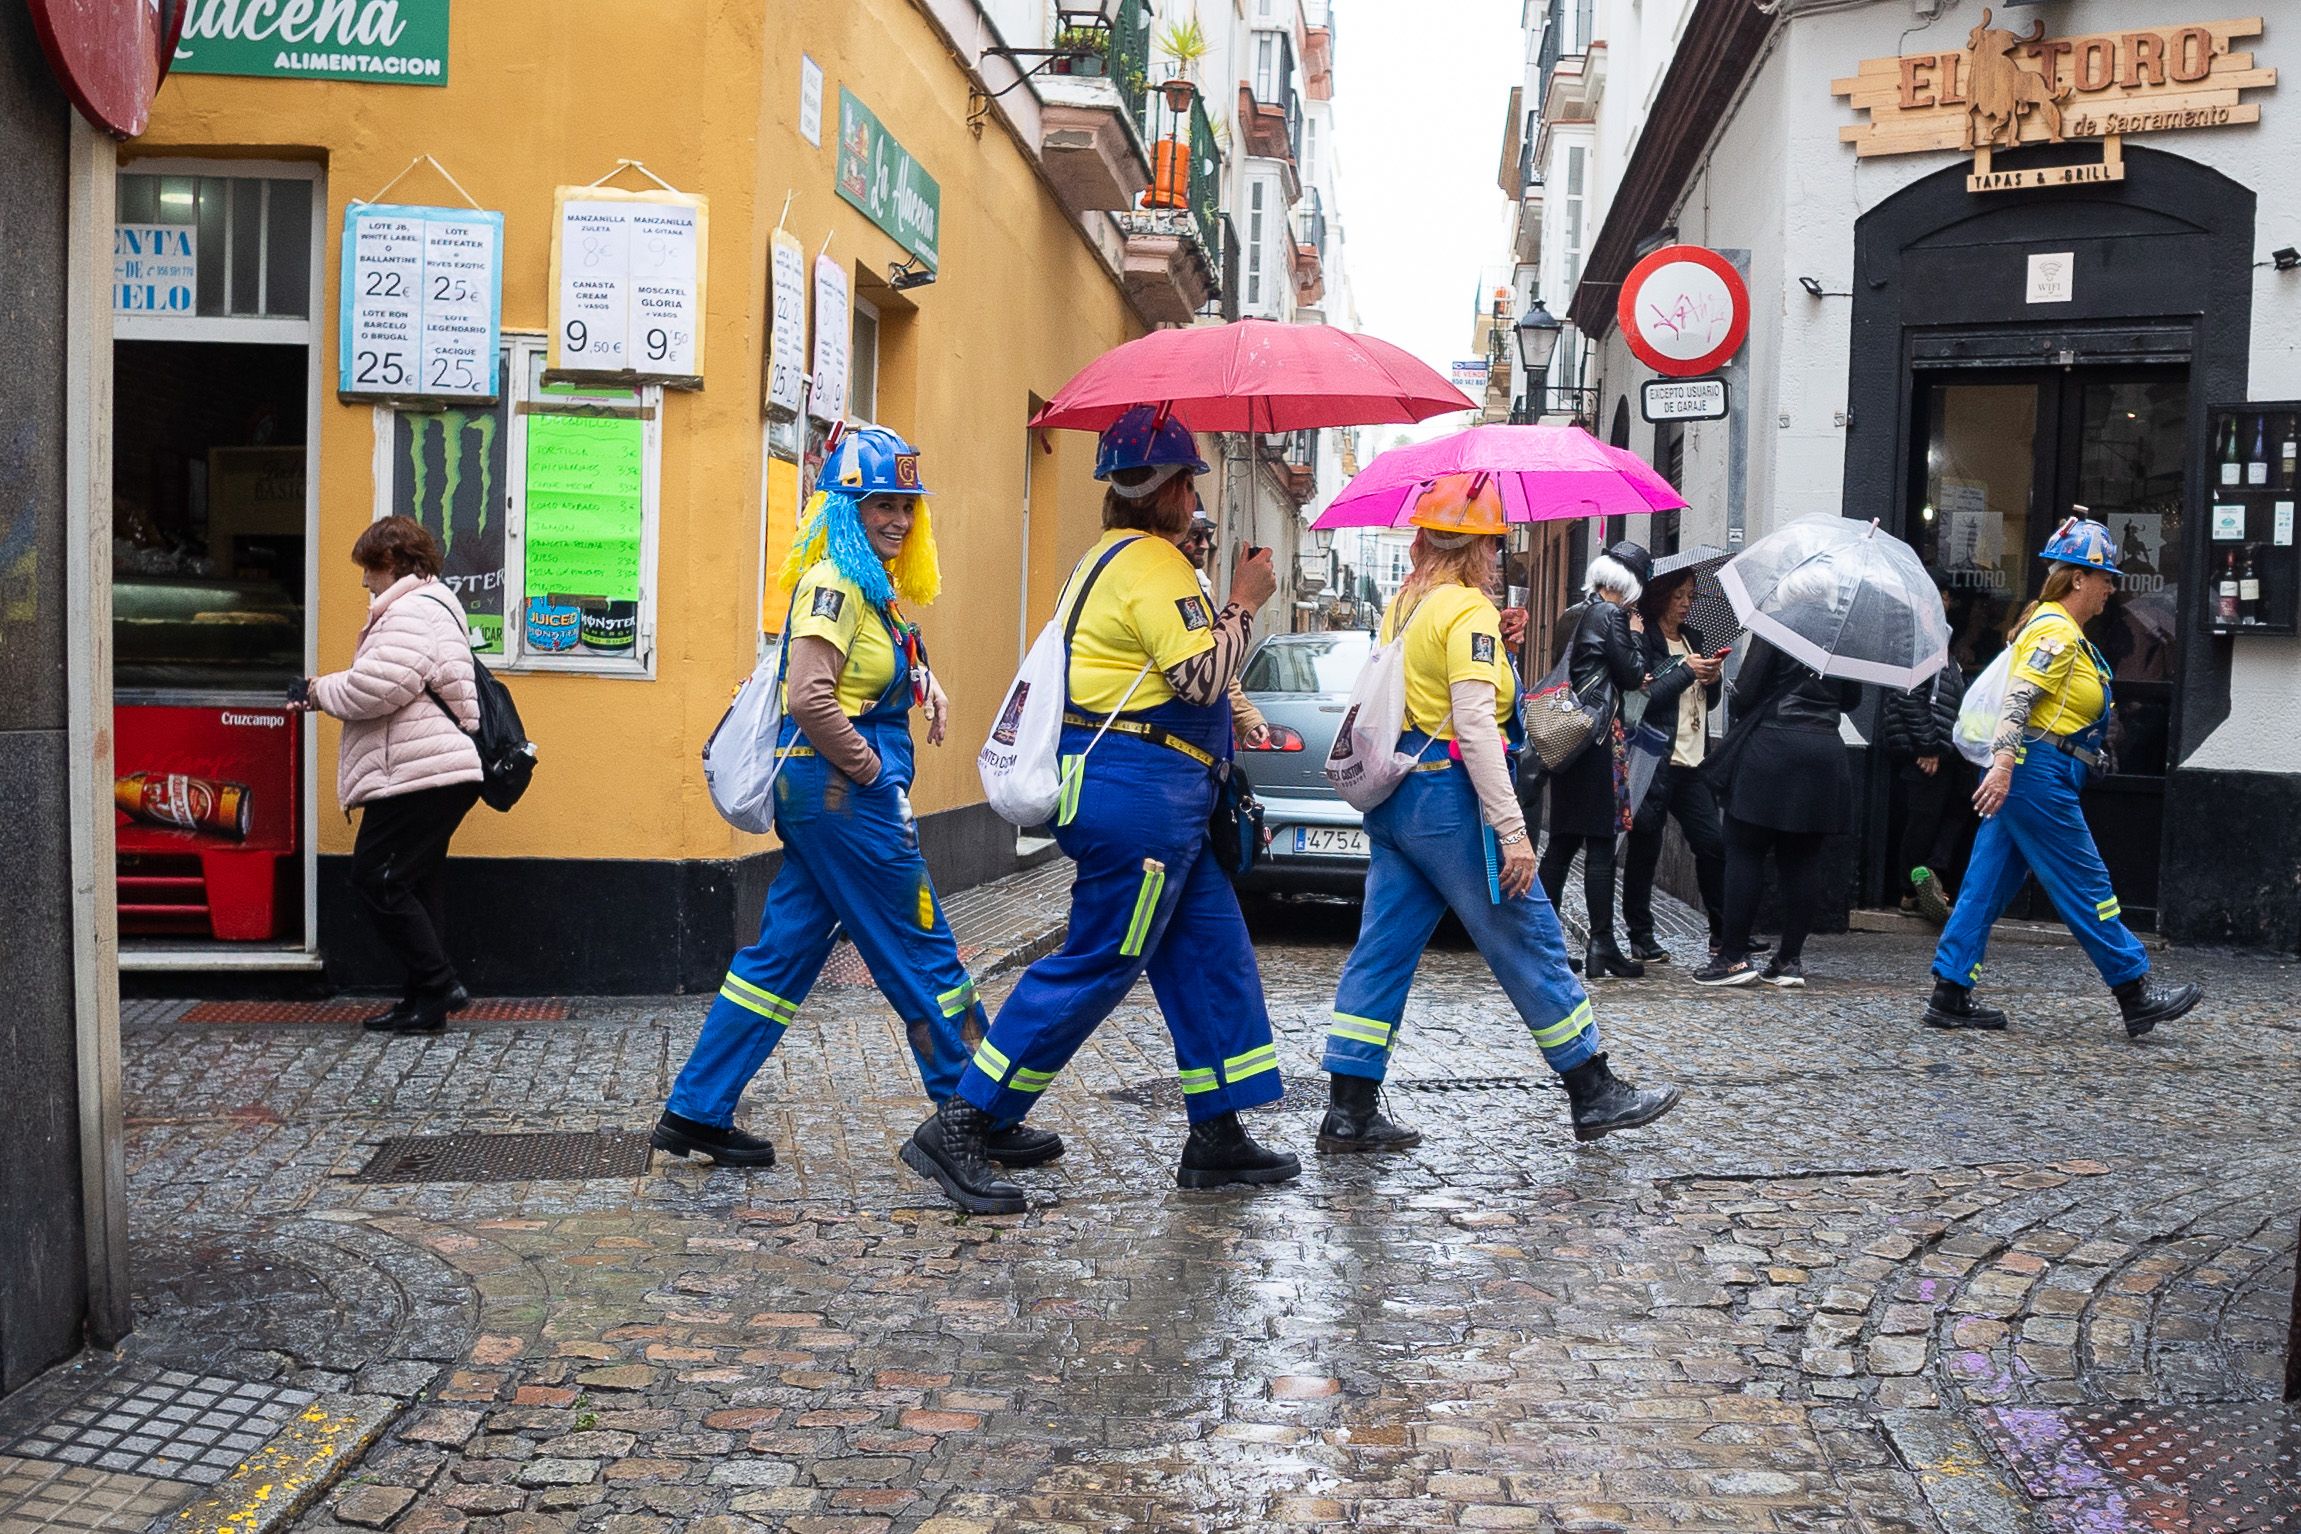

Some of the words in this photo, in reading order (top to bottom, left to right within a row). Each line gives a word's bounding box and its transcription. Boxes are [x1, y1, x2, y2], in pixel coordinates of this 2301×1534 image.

[274, 51, 441, 76] ALIMENTACION
[1898, 53, 1967, 108] EL
[2026, 26, 2217, 94] TORO
[2073, 112, 2099, 137] de
[2105, 106, 2230, 135] Sacramento
[1975, 173, 2022, 189] TAPAS
[2037, 172, 2046, 185] &
[2064, 166, 2111, 183] GRILL
[870, 134, 889, 218] La
[892, 155, 935, 242] Alacena
[567, 215, 625, 223] MANZANILLA
[634, 217, 693, 227] MANZANILLA
[369, 223, 392, 231] LOTE
[445, 228, 468, 236] LOTE
[430, 239, 484, 248] BEEFEATER
[360, 255, 417, 264] BALLANTINE
[573, 281, 615, 289] CANASTA
[638, 286, 686, 296] MOSCATEL
[641, 299, 683, 309] GLORIA
[363, 310, 387, 318] LOTE
[364, 321, 407, 330] BARCELO
[427, 325, 486, 334] LEGENDARIO
[371, 333, 409, 341] BRUGAL
[435, 347, 477, 356] CACIQUE
[1649, 386, 1684, 400] EXCEPTO
[1686, 385, 1720, 398] USUARIO
[1664, 402, 1674, 413] DE
[1677, 400, 1707, 413] GARAJE
[531, 611, 577, 627] JUICED
[221, 711, 285, 729] Cruzcampo
[1309, 830, 1362, 851] 4754
